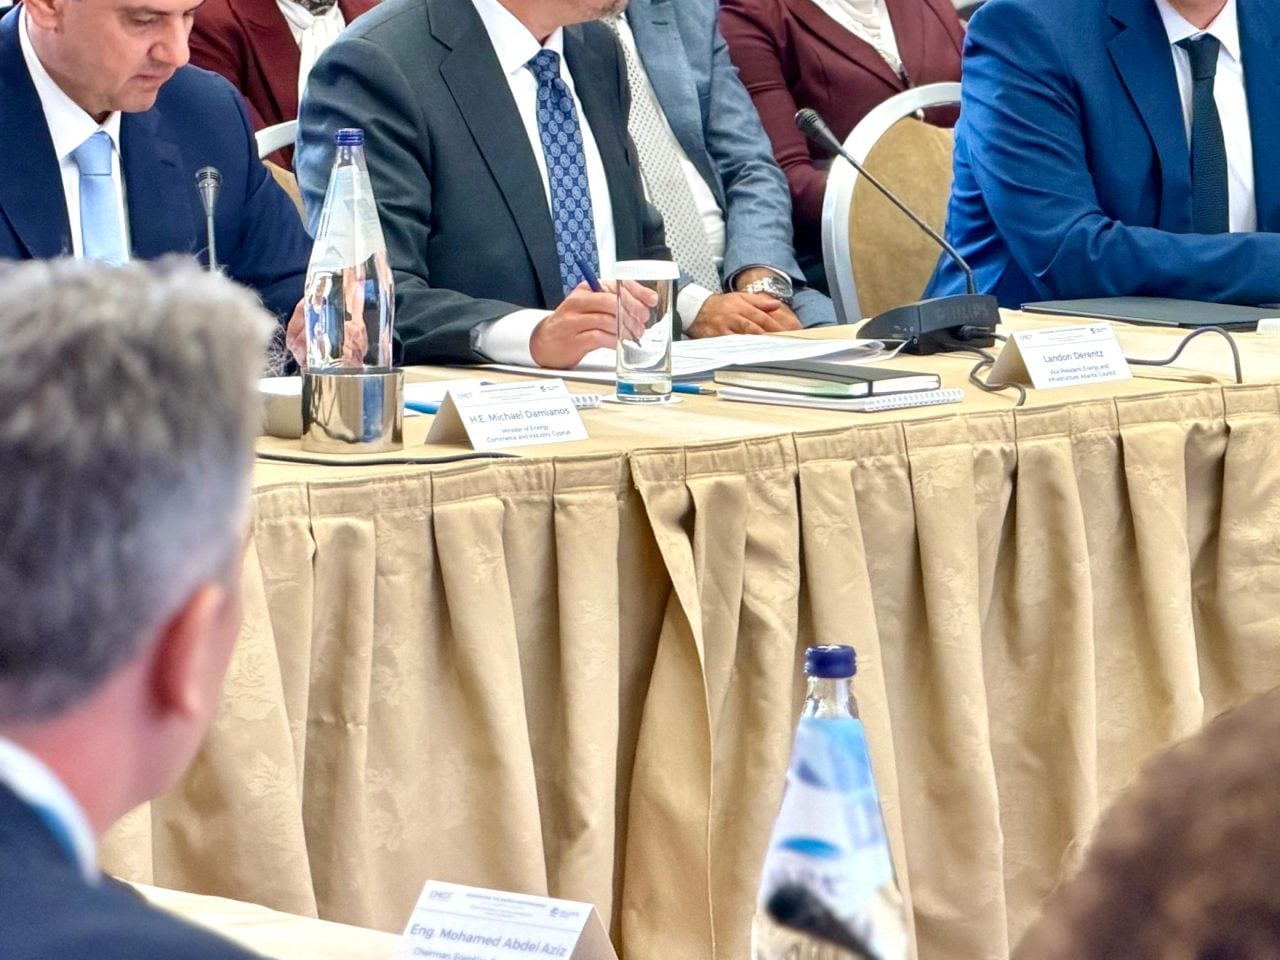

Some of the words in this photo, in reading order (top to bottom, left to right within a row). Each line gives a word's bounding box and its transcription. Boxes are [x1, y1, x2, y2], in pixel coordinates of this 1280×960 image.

[1042, 354, 1073, 363] Landon
[1073, 350, 1104, 359] Derentz
[488, 411, 524, 422] Michael
[525, 408, 570, 418] Damianos
[410, 924, 435, 940] Eng.
[439, 928, 501, 947] Mohamed
[503, 937, 541, 952] Abdel
[541, 943, 568, 957] Aziz
